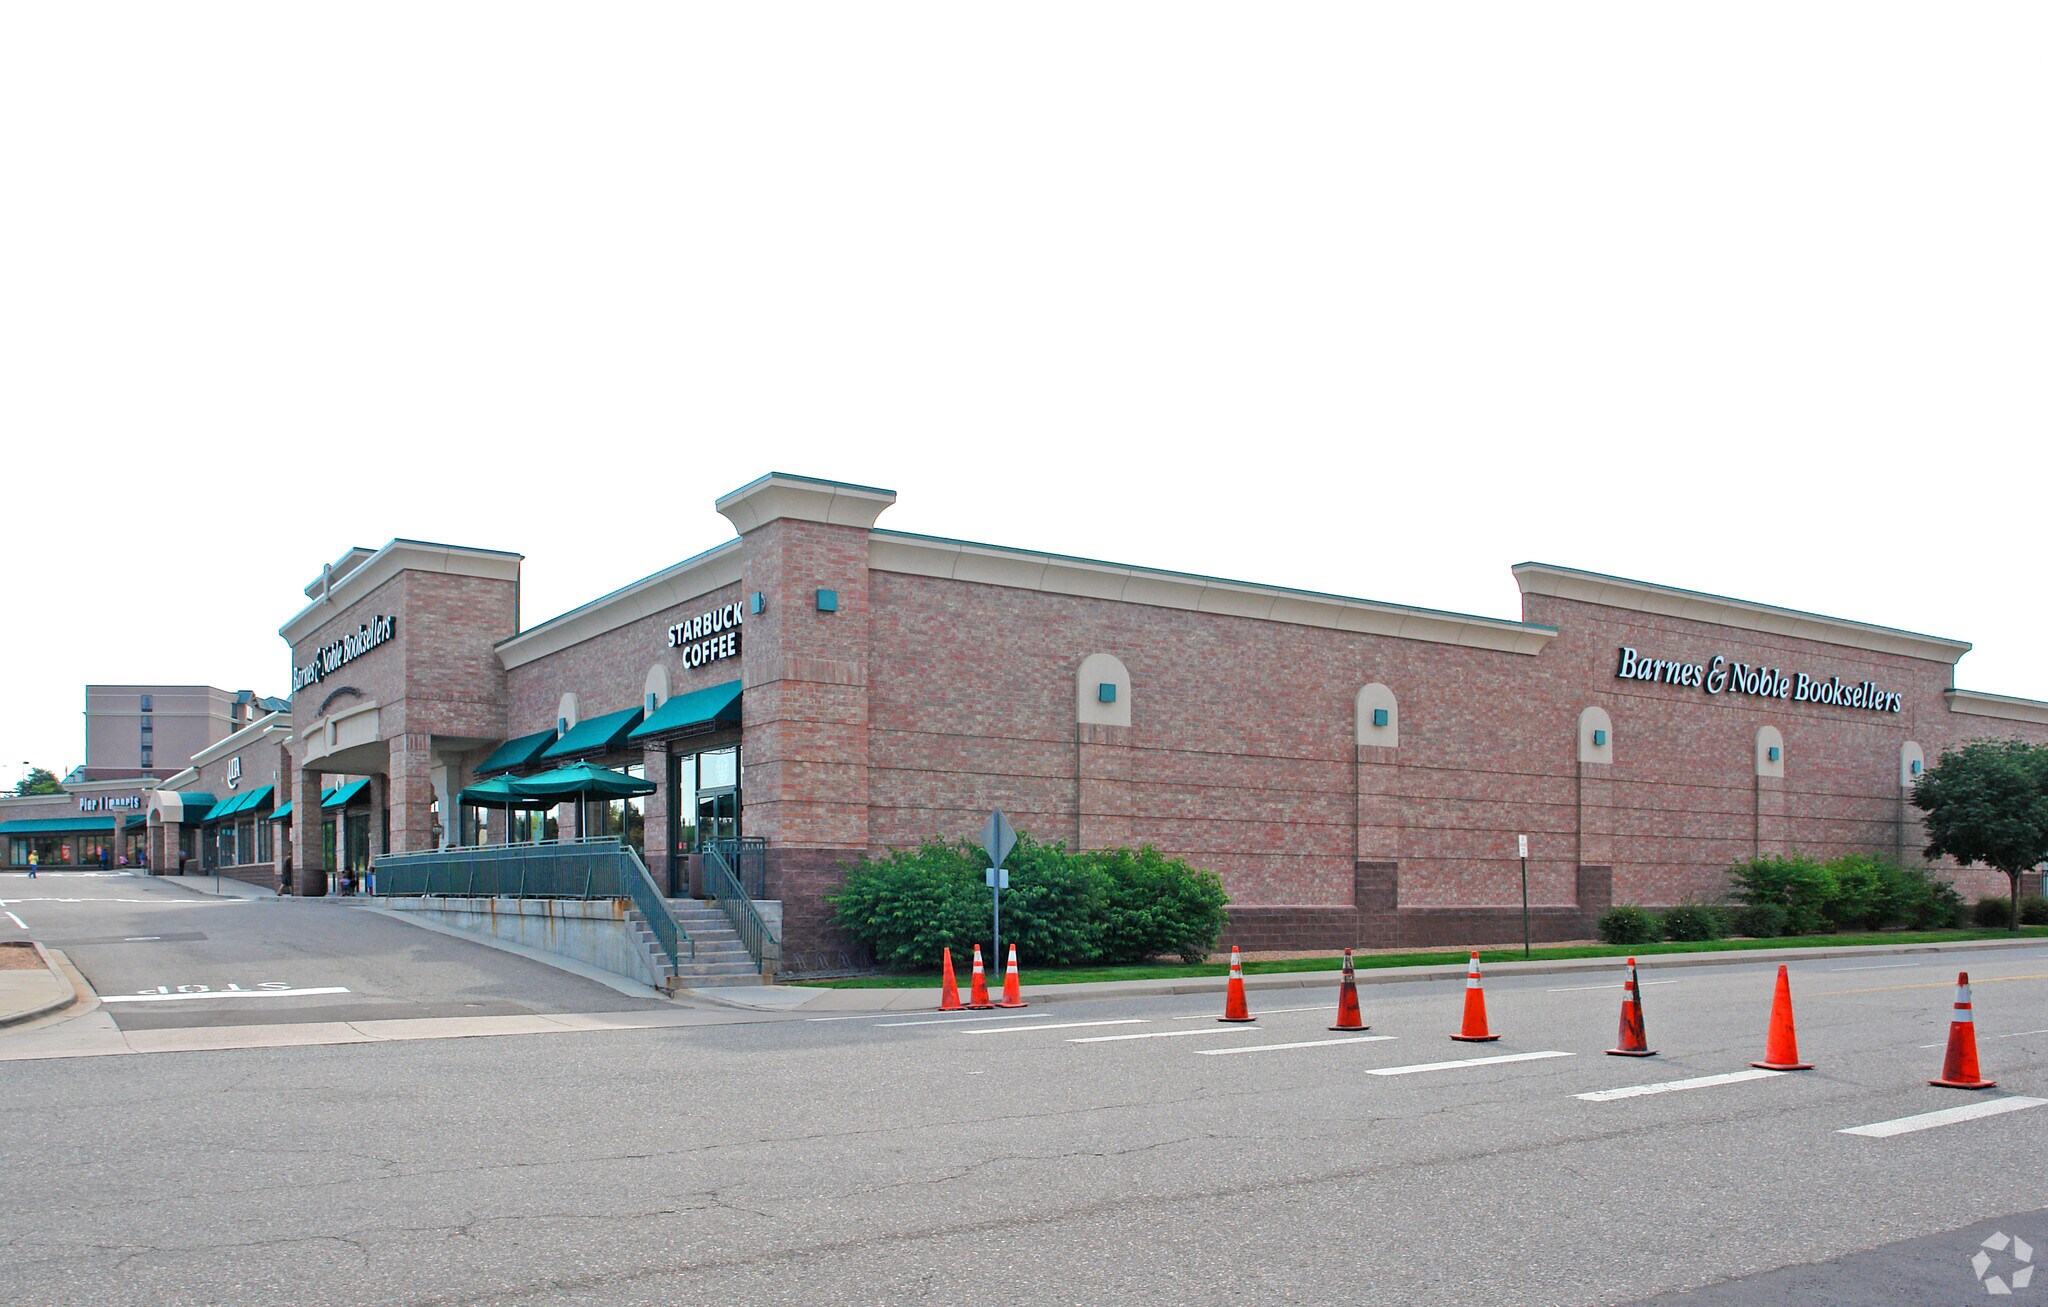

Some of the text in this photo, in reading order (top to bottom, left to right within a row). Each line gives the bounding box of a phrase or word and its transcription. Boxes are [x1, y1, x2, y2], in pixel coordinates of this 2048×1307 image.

[321, 640, 344, 676] Noble
[343, 615, 392, 664] Booksellers
[682, 631, 736, 669] COFFEE
[1619, 647, 1903, 714] Barnes & Noble Booksellers
[79, 797, 98, 811] Pier
[99, 796, 104, 810] 1
